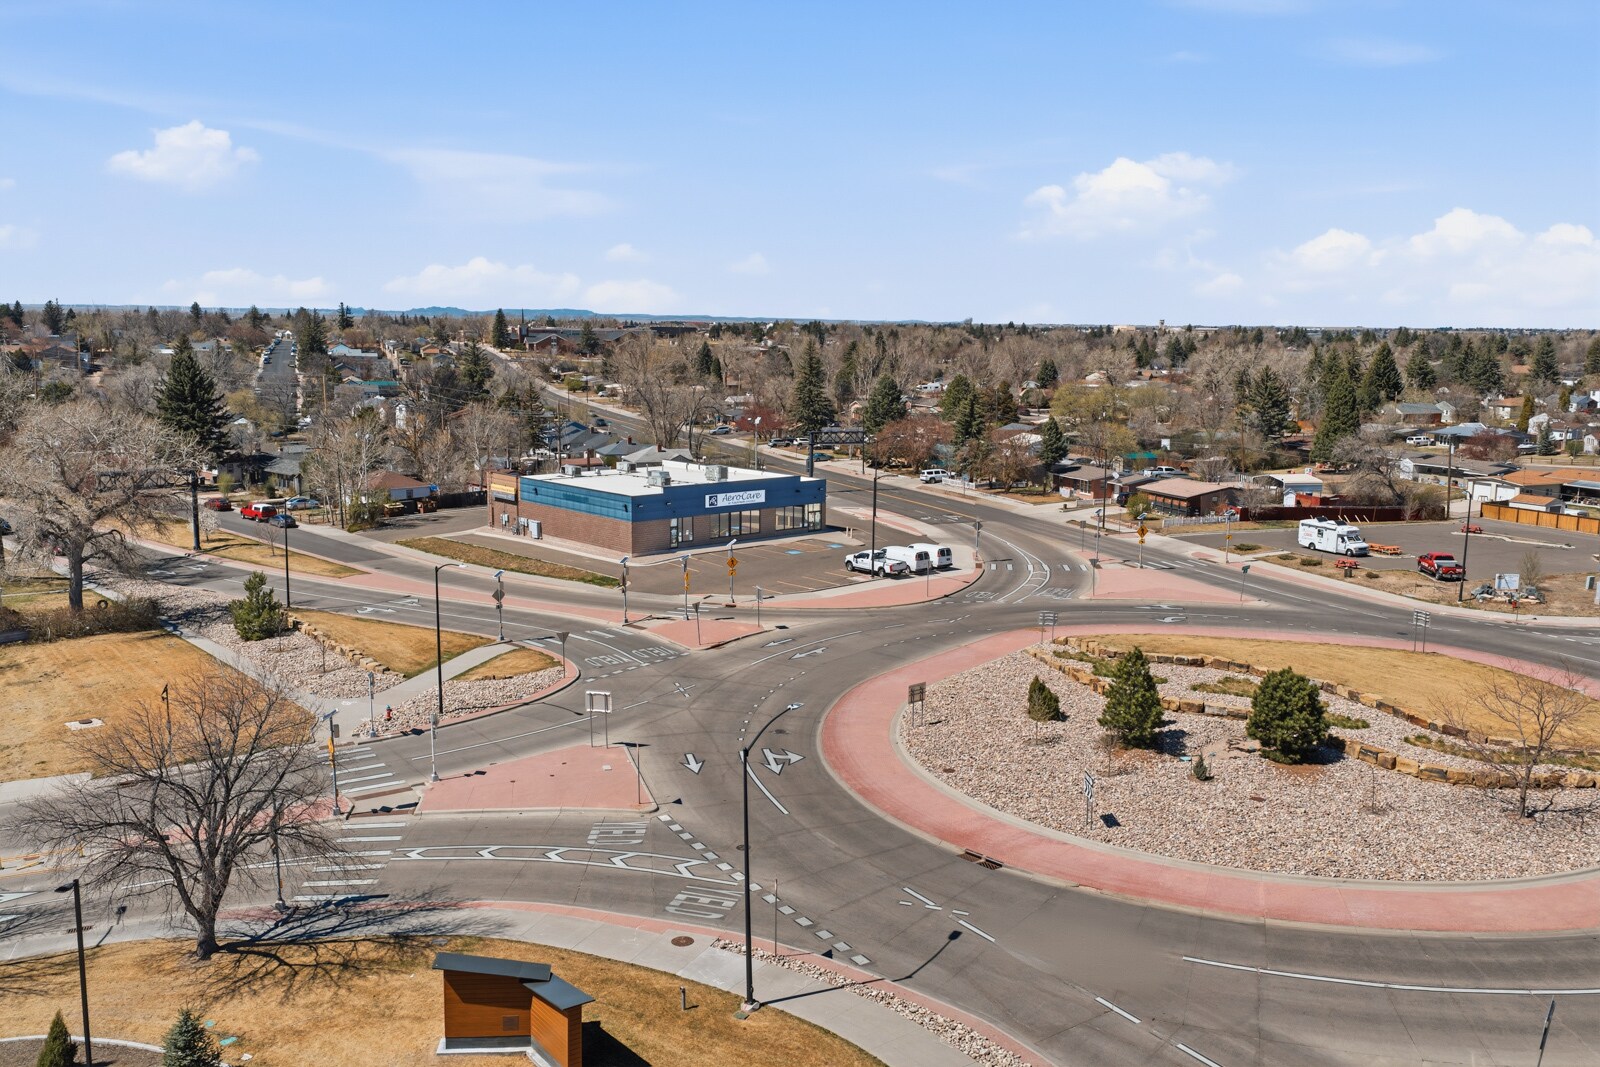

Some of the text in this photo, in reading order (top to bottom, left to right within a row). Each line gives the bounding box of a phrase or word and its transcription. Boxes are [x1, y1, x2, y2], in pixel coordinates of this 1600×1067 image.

[722, 491, 762, 502] AeroCare
[631, 646, 678, 658] YIELD
[584, 654, 632, 668] YIELD
[586, 820, 651, 846] YIELD
[664, 885, 746, 919] YIELD
